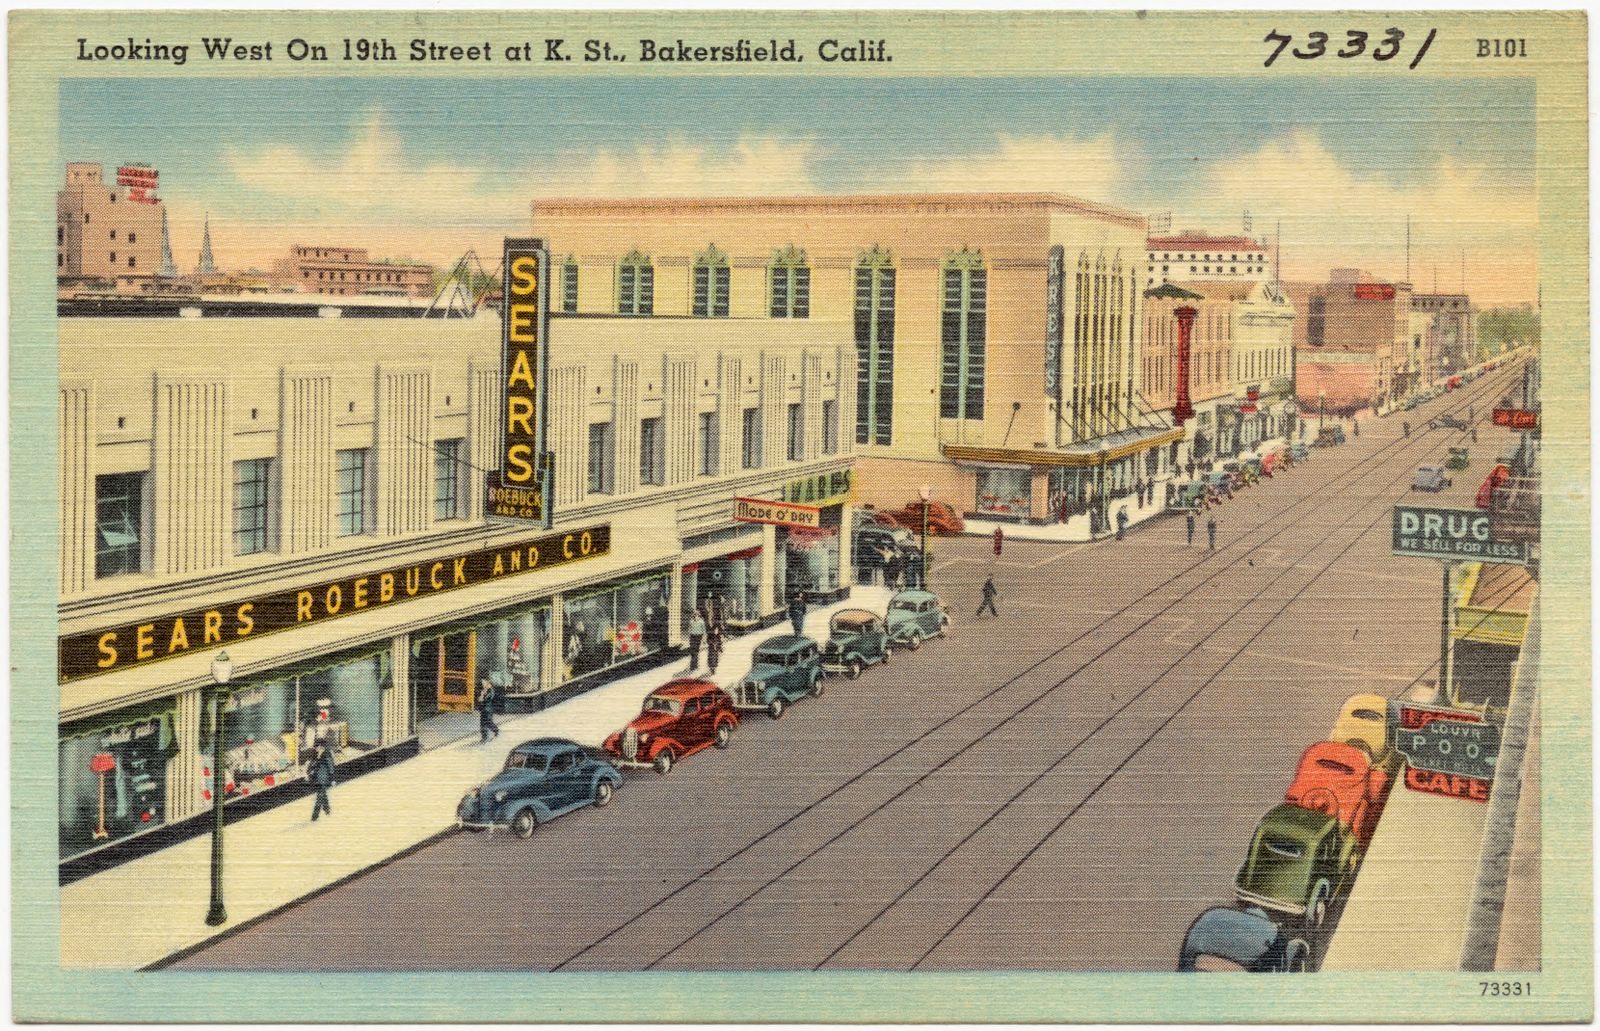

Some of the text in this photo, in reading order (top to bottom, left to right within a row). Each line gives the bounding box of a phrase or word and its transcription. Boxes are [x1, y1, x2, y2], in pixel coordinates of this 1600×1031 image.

[1263, 27, 1437, 70] 73331
[1046, 255, 1059, 388] KRESS
[507, 256, 537, 482] SEARS
[488, 487, 542, 508] ROEBUCK
[1400, 511, 1489, 541] DRUG
[1400, 538, 1418, 549] WE
[1456, 541, 1482, 553] FOR
[1486, 544, 1520, 557] LESS
[97, 532, 598, 668] SEARS ROEBUCK AND CO.
[1407, 769, 1488, 799] CAFE
